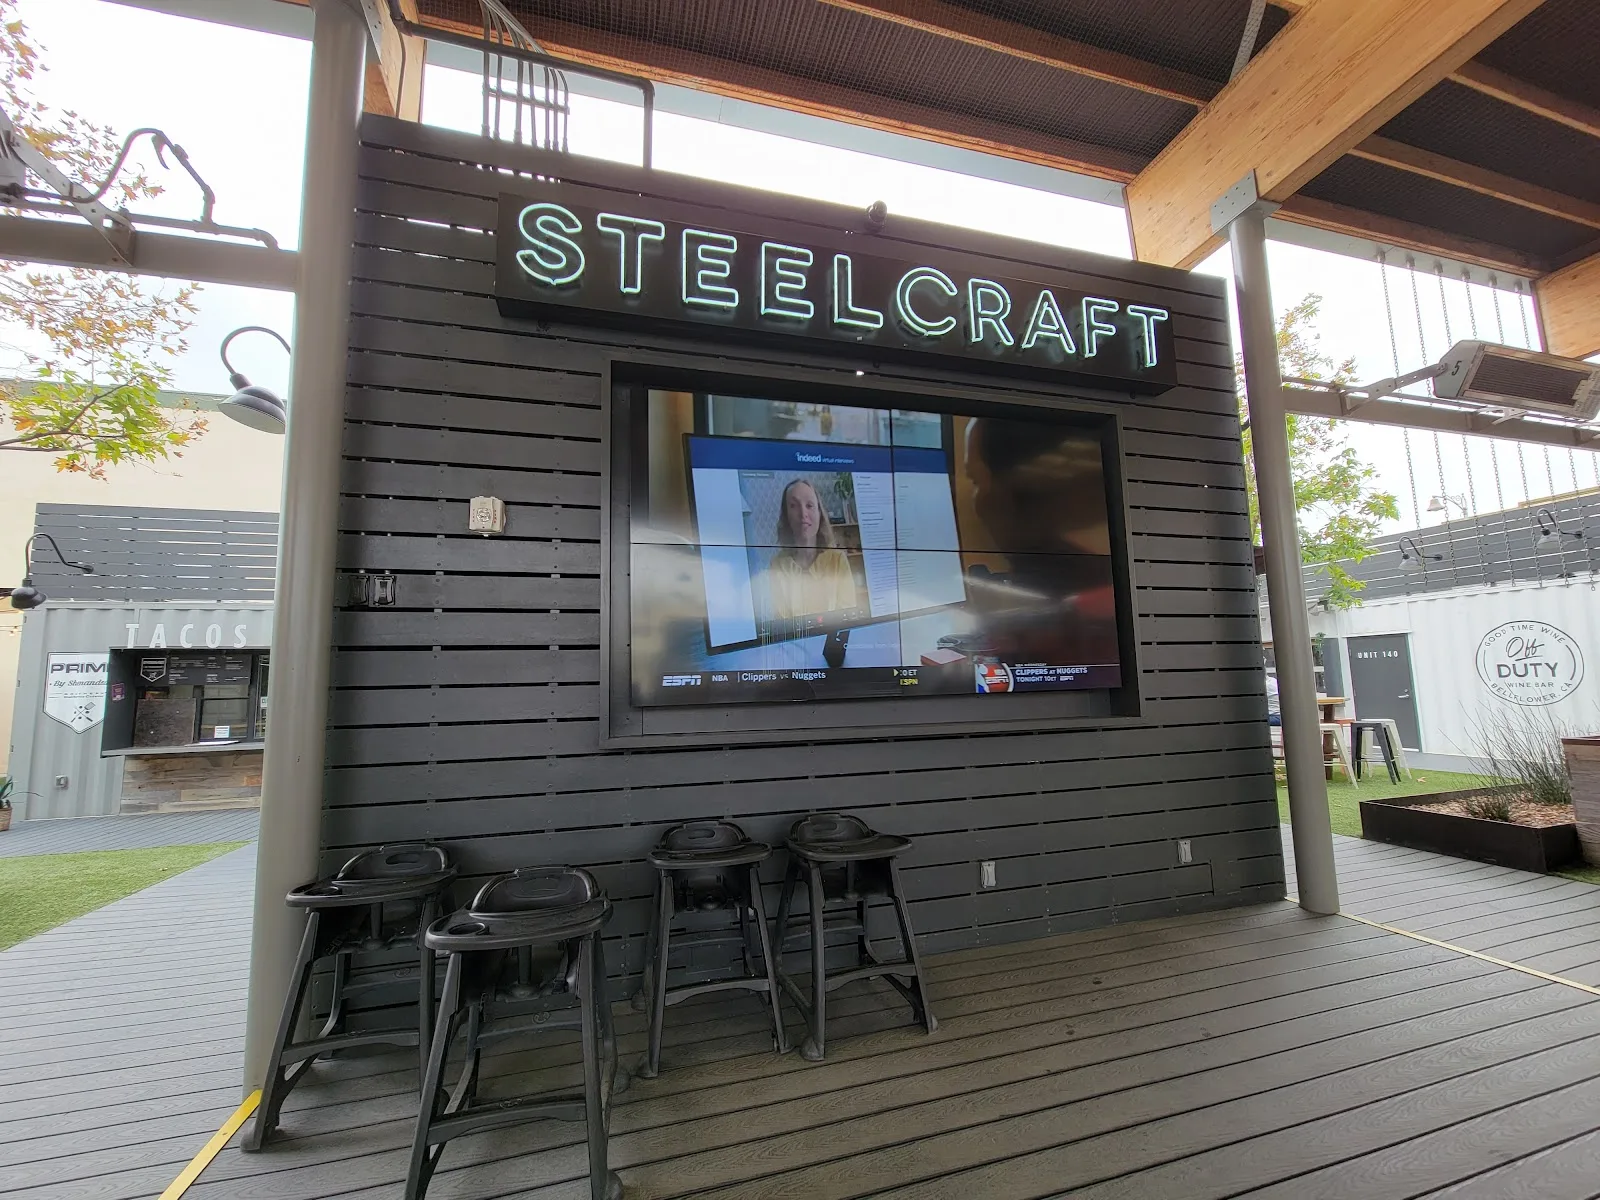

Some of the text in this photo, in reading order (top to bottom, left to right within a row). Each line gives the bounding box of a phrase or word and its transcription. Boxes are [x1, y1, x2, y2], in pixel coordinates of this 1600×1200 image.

[514, 202, 1169, 368] STEELCRAFT
[1451, 360, 1462, 376] 5
[125, 623, 247, 649] TACOS
[1485, 624, 1566, 647] GOOD TIME WINE
[1505, 636, 1545, 658] Off
[1357, 650, 1399, 659] UNIT 140
[50, 662, 109, 674] PRIM
[1496, 662, 1559, 678] DUTY
[662, 674, 702, 687] ESPN
[711, 674, 729, 682] NBA
[741, 672, 777, 683] Clippers
[791, 670, 827, 682] Nuggets
[1560, 682, 1573, 692] CA
